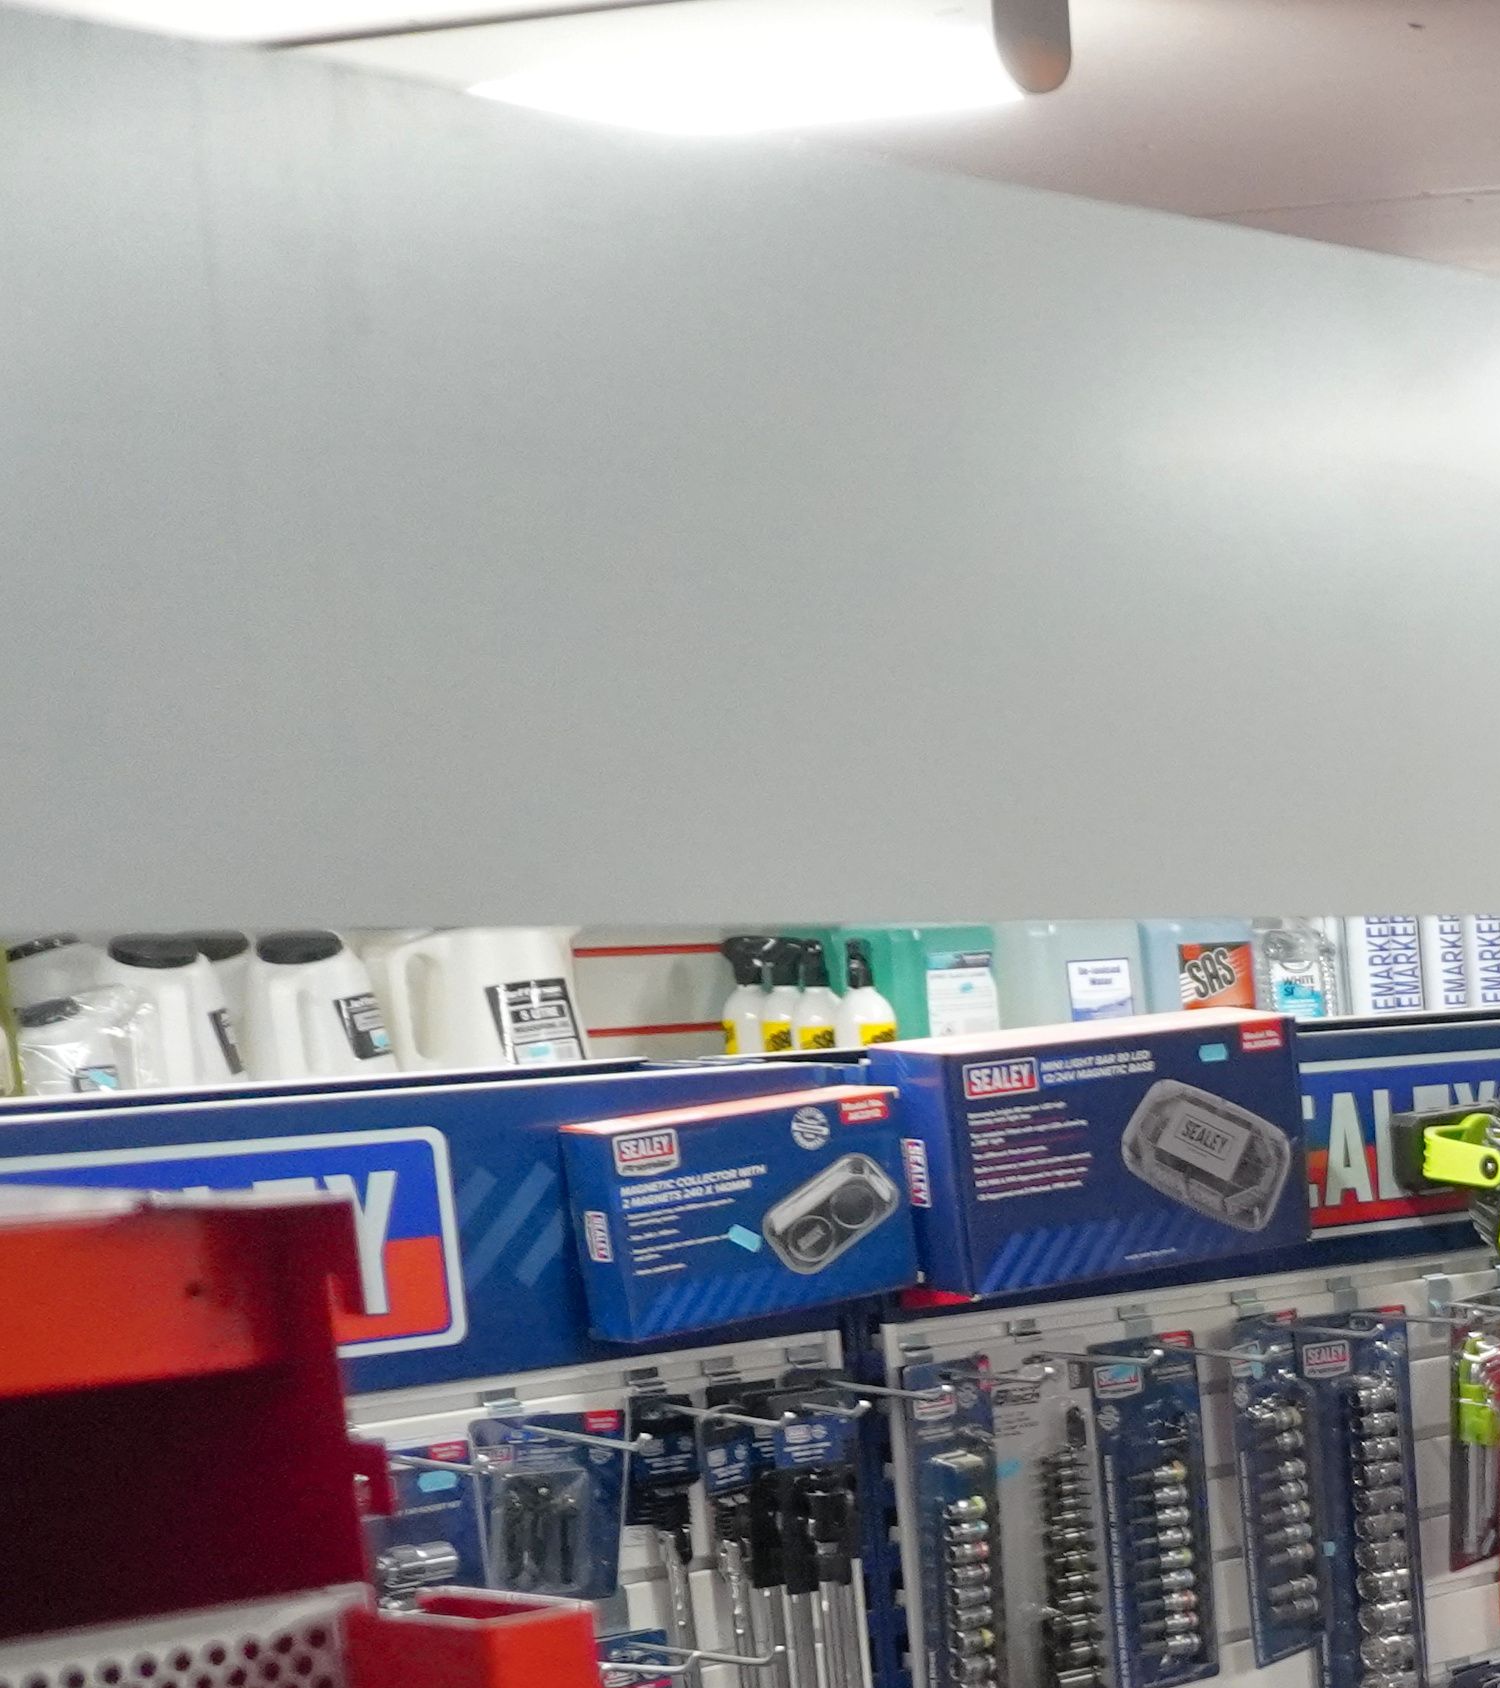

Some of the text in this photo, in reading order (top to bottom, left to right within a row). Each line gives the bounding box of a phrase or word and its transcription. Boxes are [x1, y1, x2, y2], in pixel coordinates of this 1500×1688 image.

[1186, 947, 1236, 1000] SAS
[970, 1063, 1033, 1093] SEALEY
[619, 1137, 673, 1161] SEALEY
[1180, 1121, 1228, 1152] SEALEY
[1306, 1347, 1349, 1368] SEALEY
